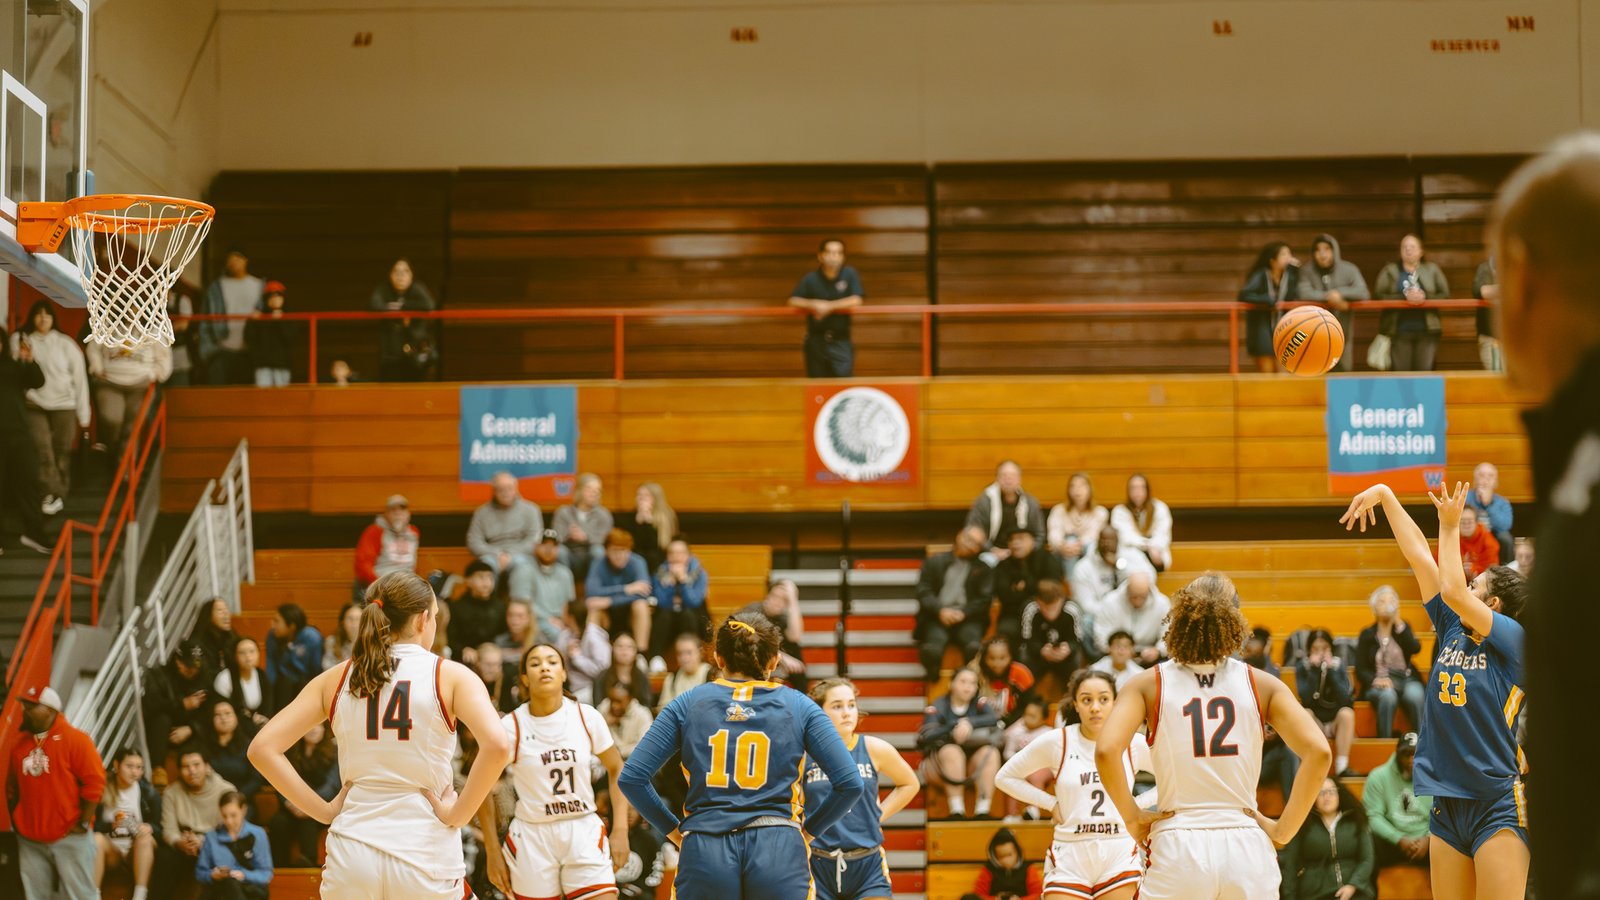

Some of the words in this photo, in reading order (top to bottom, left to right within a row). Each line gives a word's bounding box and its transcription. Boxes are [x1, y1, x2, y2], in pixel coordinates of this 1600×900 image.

[1280, 330, 1308, 368] Wilson
[480, 412, 557, 438] General
[1349, 402, 1425, 429] General
[469, 439, 567, 464] Admission
[1339, 430, 1436, 455] Admission
[1194, 672, 1216, 688] W
[1438, 671, 1467, 707] 33
[360, 680, 412, 741] 14
[1183, 696, 1238, 757] 12
[540, 749, 577, 765] WEST
[706, 728, 771, 790] 10
[549, 767, 575, 795] 21
[1080, 771, 1101, 786] WE
[545, 799, 590, 815] AURORA
[1090, 789, 1105, 816] 2
